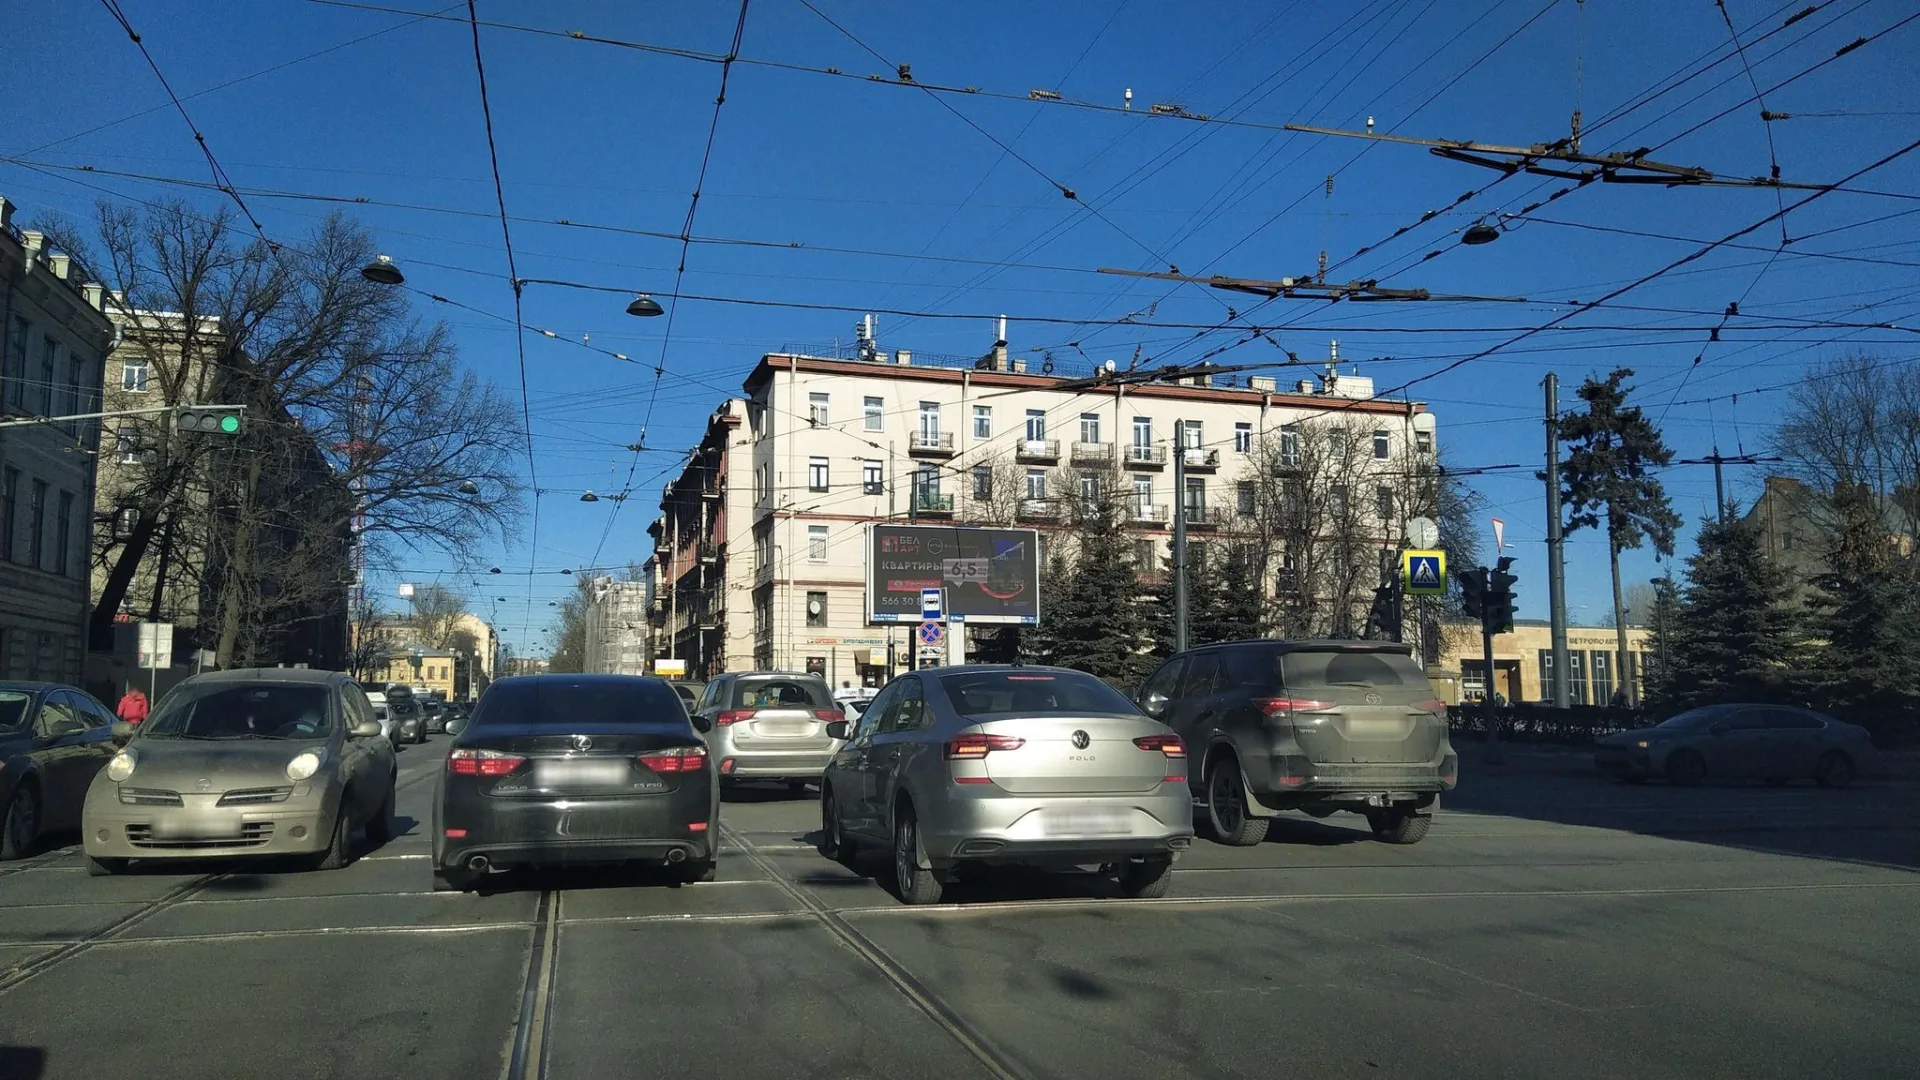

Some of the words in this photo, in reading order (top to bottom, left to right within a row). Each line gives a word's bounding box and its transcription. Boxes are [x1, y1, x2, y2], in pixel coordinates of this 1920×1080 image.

[900, 536, 920, 544] БЕЛ
[882, 561, 943, 570] КВАРТИРЫ
[951, 562, 976, 579] 6,5
[882, 597, 899, 605] 566
[902, 597, 913, 605] 30
